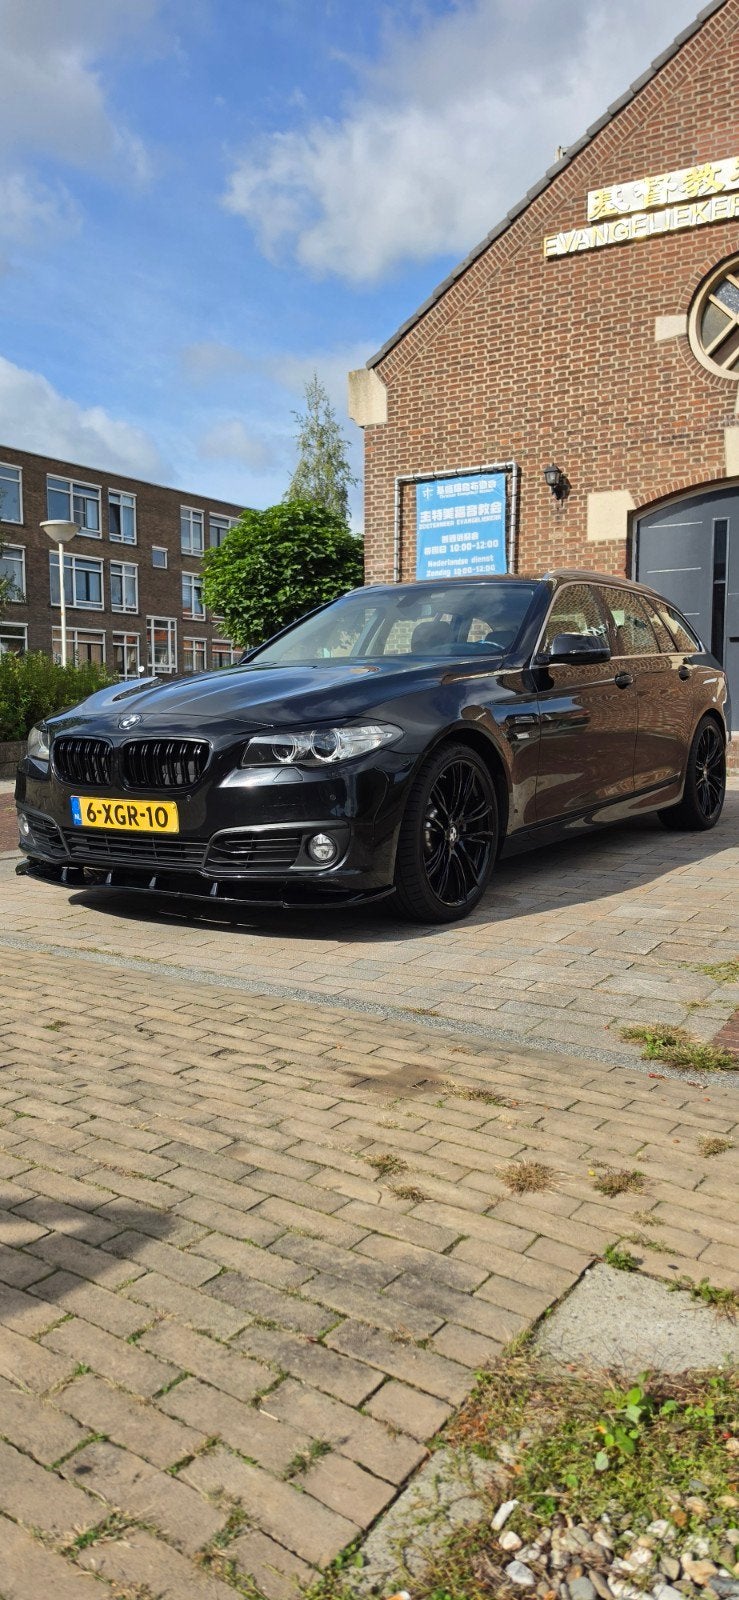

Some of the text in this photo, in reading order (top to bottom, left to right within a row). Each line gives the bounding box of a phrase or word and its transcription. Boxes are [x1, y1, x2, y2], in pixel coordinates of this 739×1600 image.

[450, 539, 499, 552] 10:00-12:00
[427, 555, 494, 568] Nederlandse dienst
[427, 569, 450, 578] Zondag
[74, 813, 81, 821] NL
[86, 802, 169, 828] 6-XGR-10
